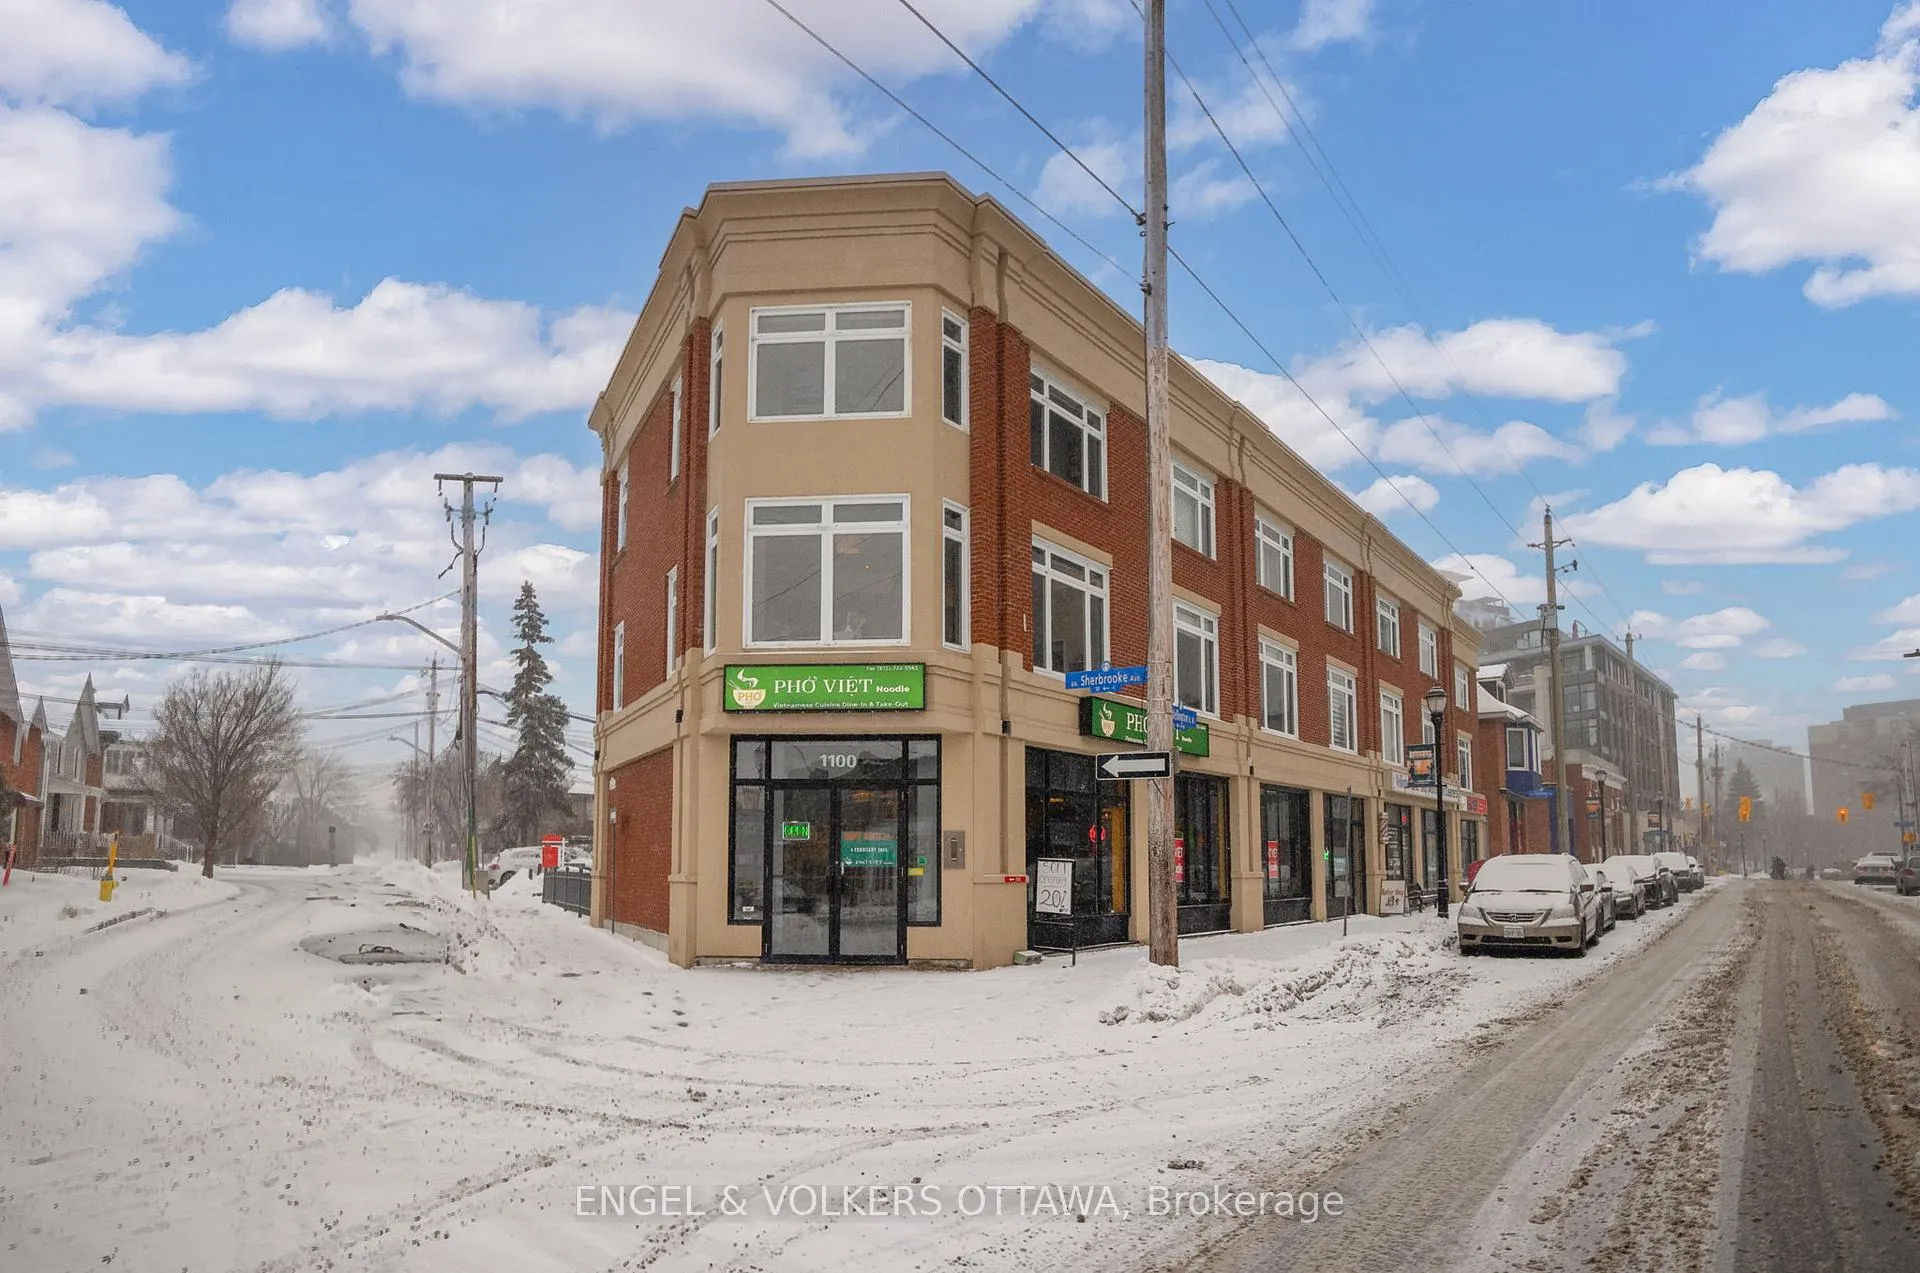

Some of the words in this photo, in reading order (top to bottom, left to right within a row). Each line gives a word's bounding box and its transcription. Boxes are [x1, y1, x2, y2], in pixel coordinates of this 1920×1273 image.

[824, 675, 873, 697] VIỆT
[876, 685, 910, 693] Noodle
[1080, 672, 1128, 686] Sherbrooke
[820, 754, 857, 768] 1100
